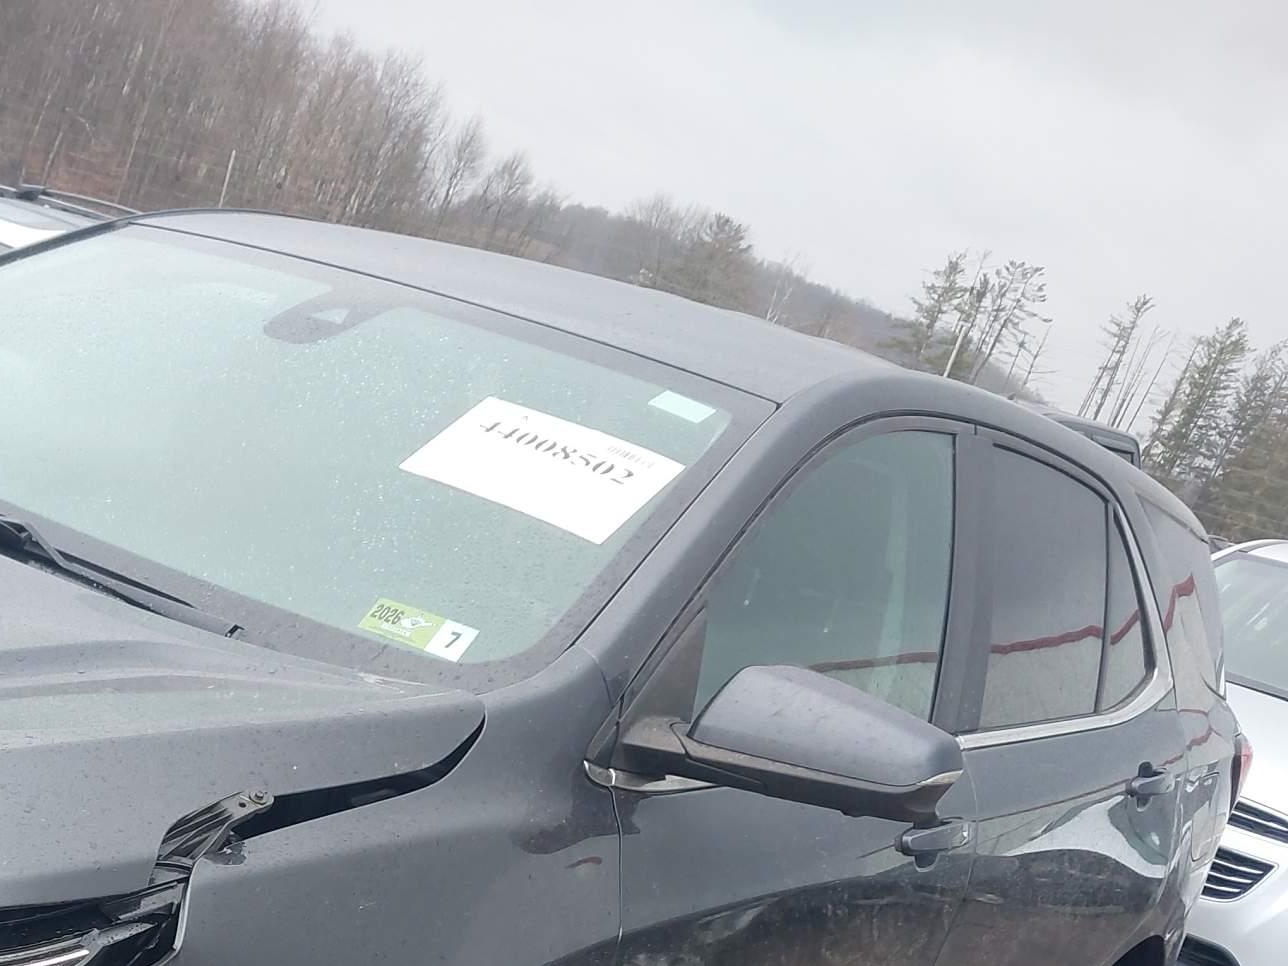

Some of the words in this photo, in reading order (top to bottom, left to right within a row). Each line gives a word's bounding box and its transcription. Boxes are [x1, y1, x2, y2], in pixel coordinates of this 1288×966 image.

[480, 421, 634, 485] 44008502
[370, 604, 405, 625] 2026
[443, 631, 463, 649] 7
